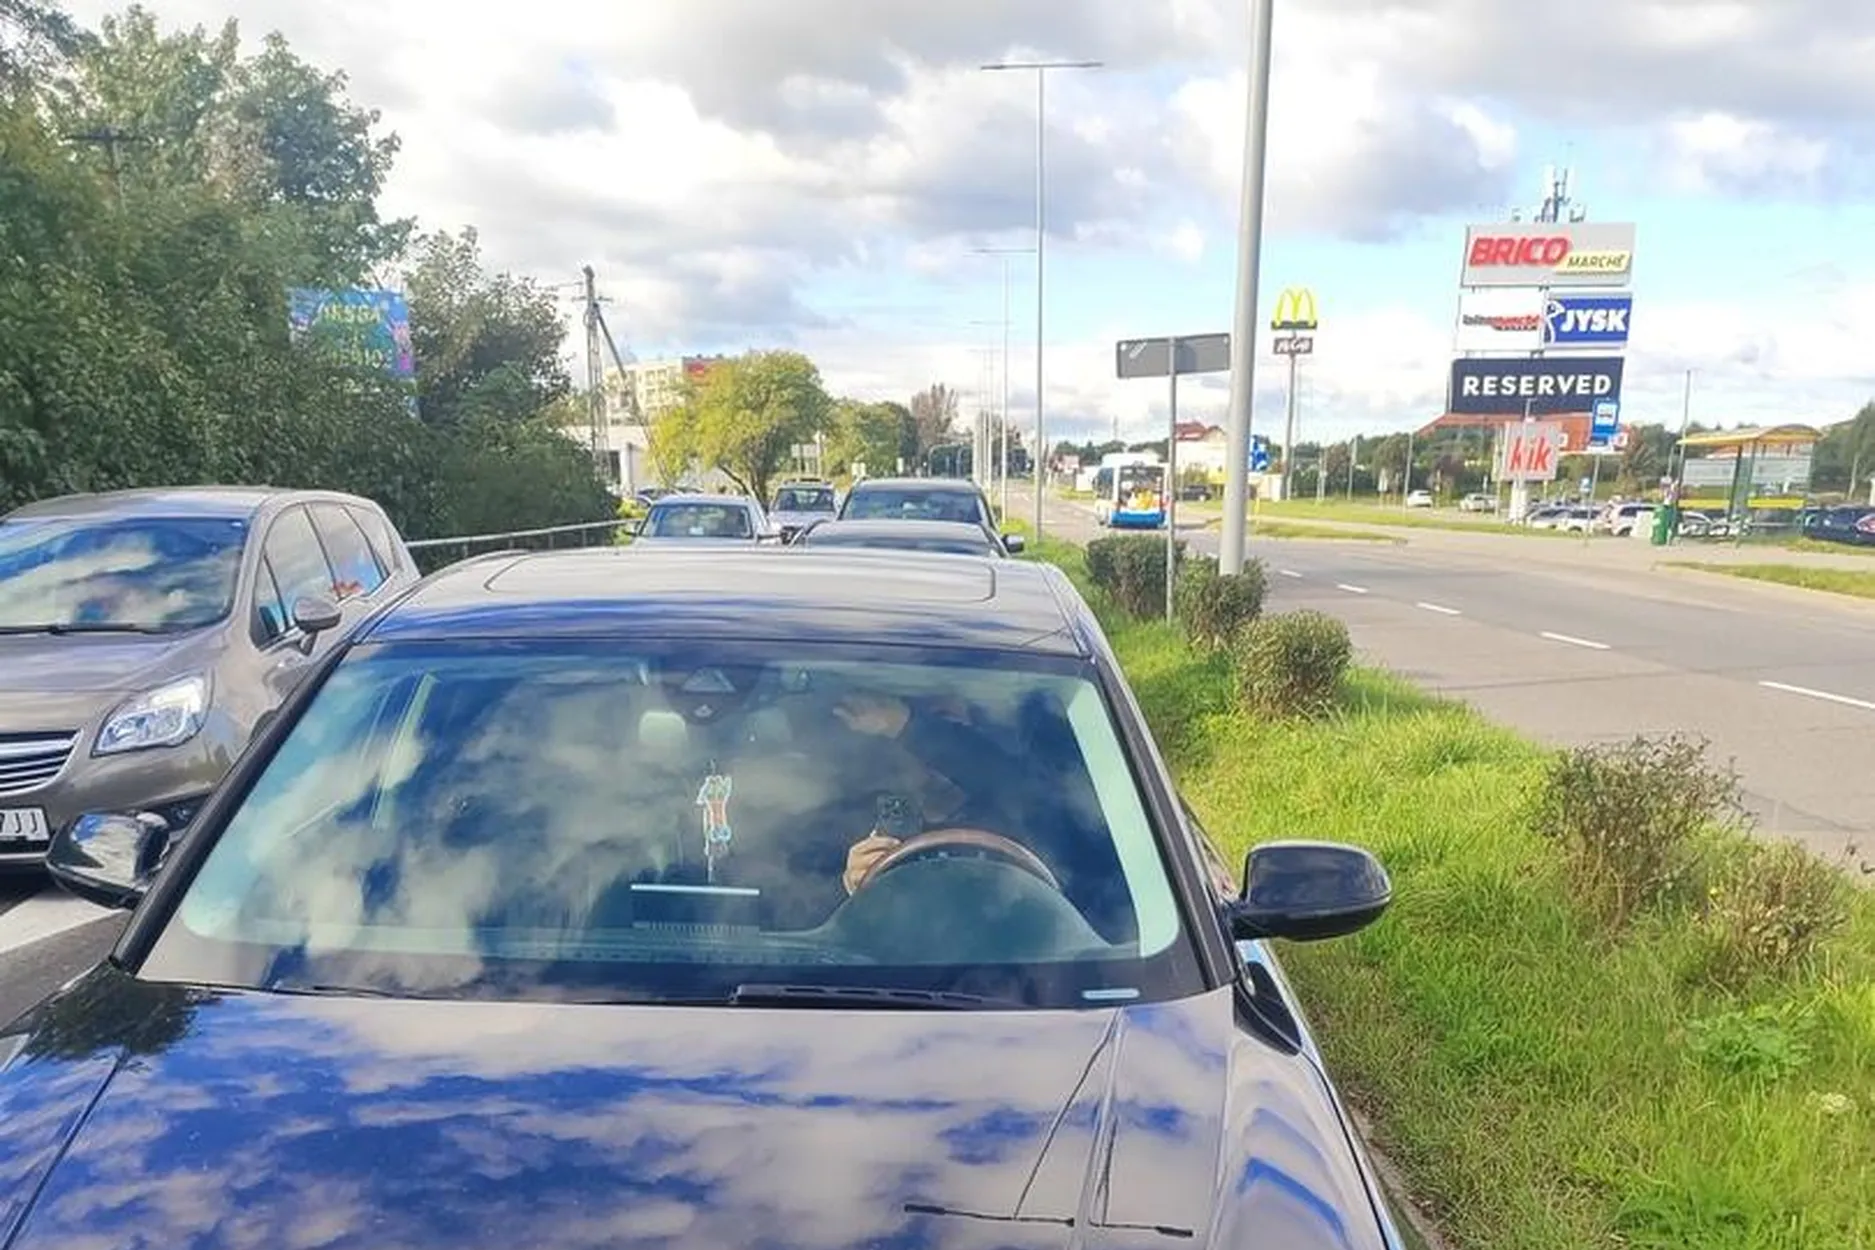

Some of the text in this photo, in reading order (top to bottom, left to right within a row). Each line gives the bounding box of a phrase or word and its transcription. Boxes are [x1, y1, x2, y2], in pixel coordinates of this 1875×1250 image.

[1469, 237, 1569, 266] BRICO
[1560, 308, 1627, 332] JYSK
[1462, 374, 1612, 396] RESERVED
